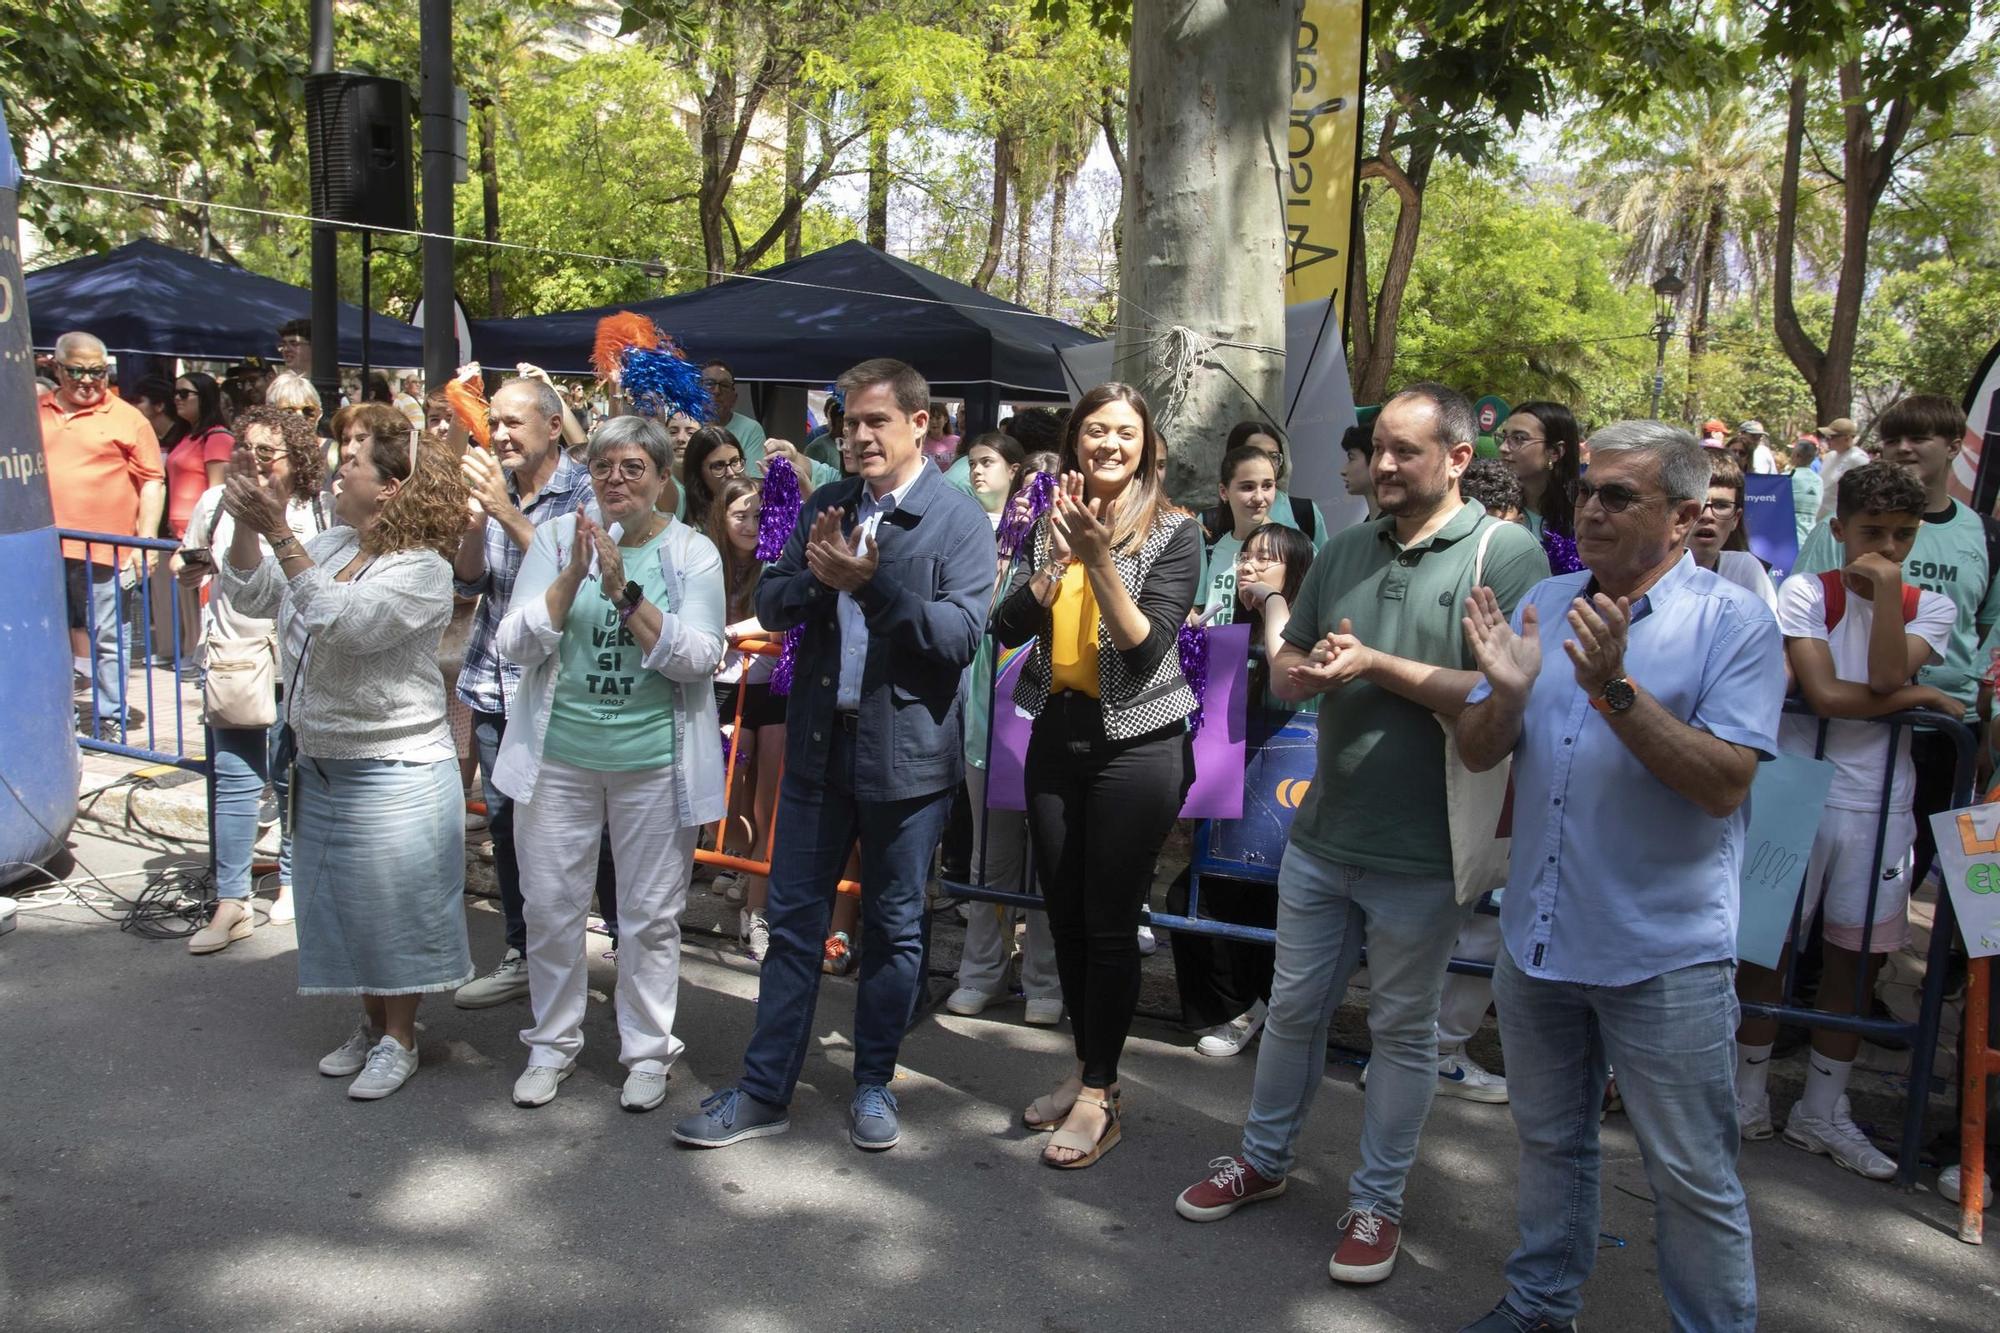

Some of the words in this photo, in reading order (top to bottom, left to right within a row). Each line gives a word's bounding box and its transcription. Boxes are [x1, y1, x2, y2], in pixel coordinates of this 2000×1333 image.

[1744, 494, 1777, 504] inyent
[1909, 560, 1958, 582] SOM
[1214, 574, 1235, 589] SO
[1213, 613, 1232, 625] VE
[592, 626, 635, 648] VER
[598, 652, 622, 671] SI
[586, 674, 634, 696] TAT
